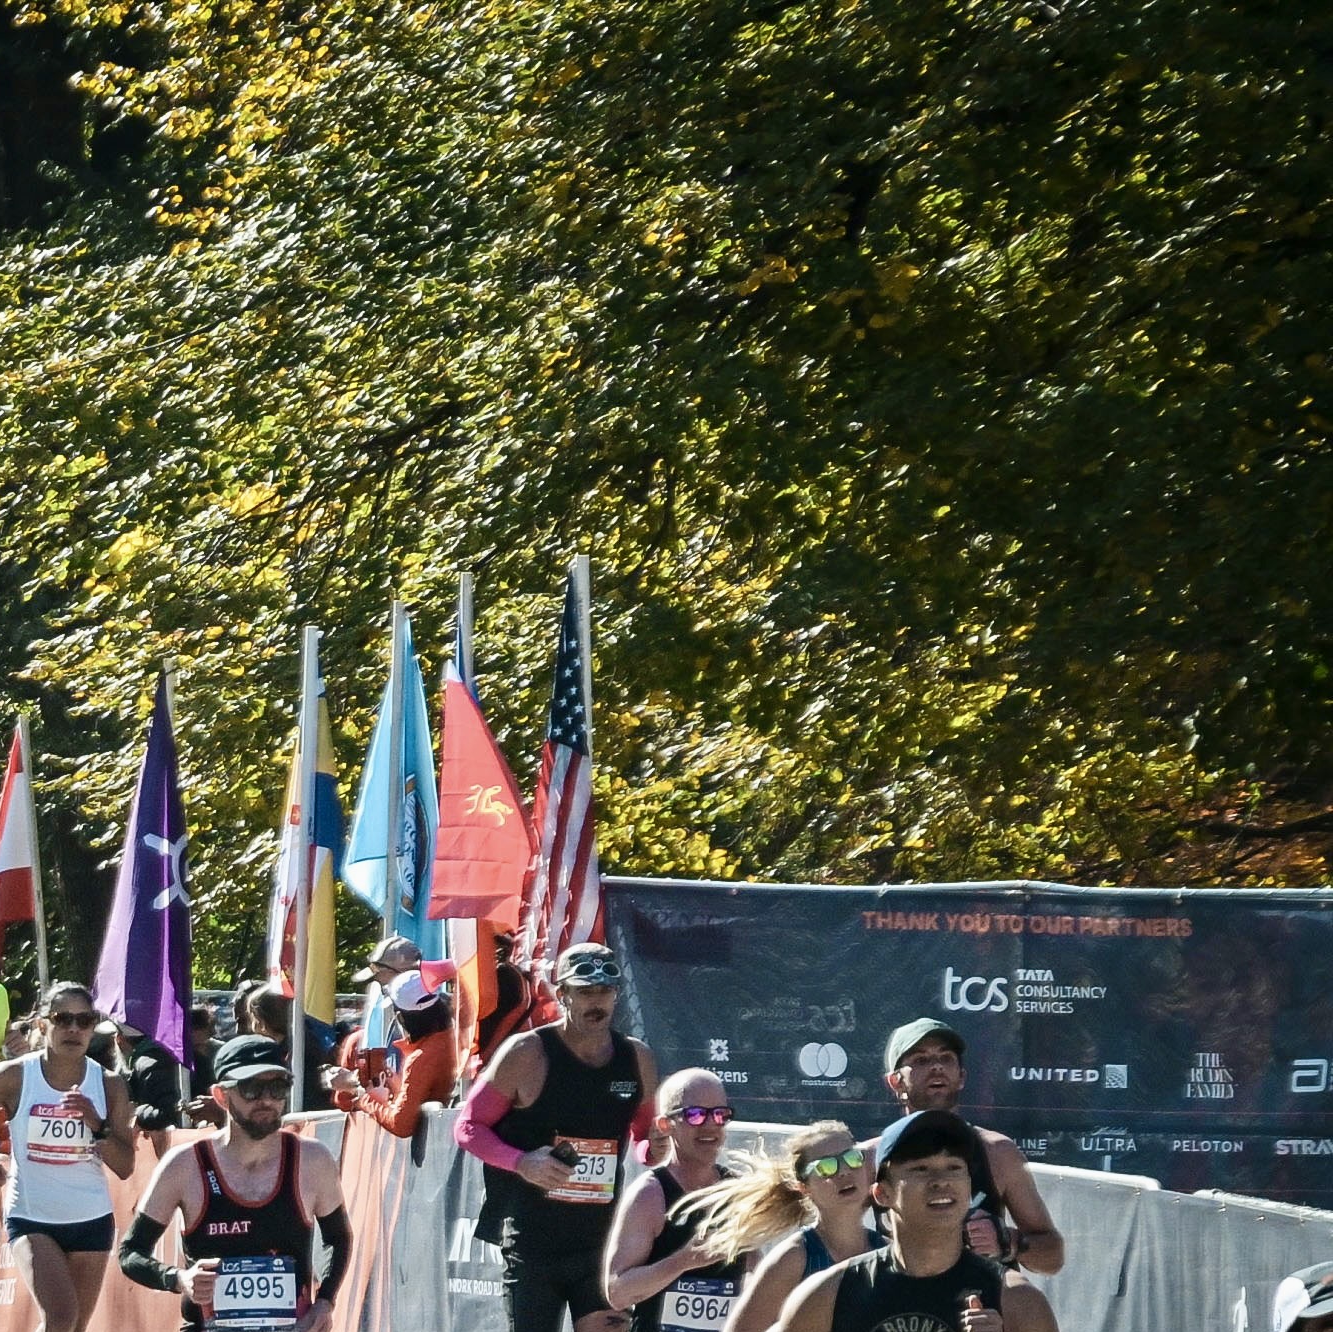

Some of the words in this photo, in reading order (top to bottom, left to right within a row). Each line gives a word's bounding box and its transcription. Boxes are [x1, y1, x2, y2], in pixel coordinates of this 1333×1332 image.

[862, 911, 939, 931] THANK
[946, 912, 991, 934] YOU
[996, 914, 1024, 934] TO
[1029, 914, 1078, 936] OUR
[1079, 916, 1194, 938] PARTNERS
[1017, 968, 1055, 982] TATA
[944, 966, 1009, 1013] tcs
[1016, 984, 1107, 999] CONSULTANCY
[1016, 1000, 1074, 1014] SERVICES
[1194, 1052, 1224, 1067] THE
[1010, 1066, 1100, 1082] UNITED
[1190, 1067, 1234, 1082] RUDIN
[802, 1078, 847, 1087] mastercard
[1185, 1083, 1237, 1099] FAMILY
[40, 1119, 84, 1139] 7601
[1081, 1137, 1137, 1151] ULTRA
[1173, 1139, 1244, 1152] PELOTON
[207, 1220, 252, 1236] BRAT
[224, 1276, 284, 1299] 4995
[675, 1296, 729, 1321] 6964
